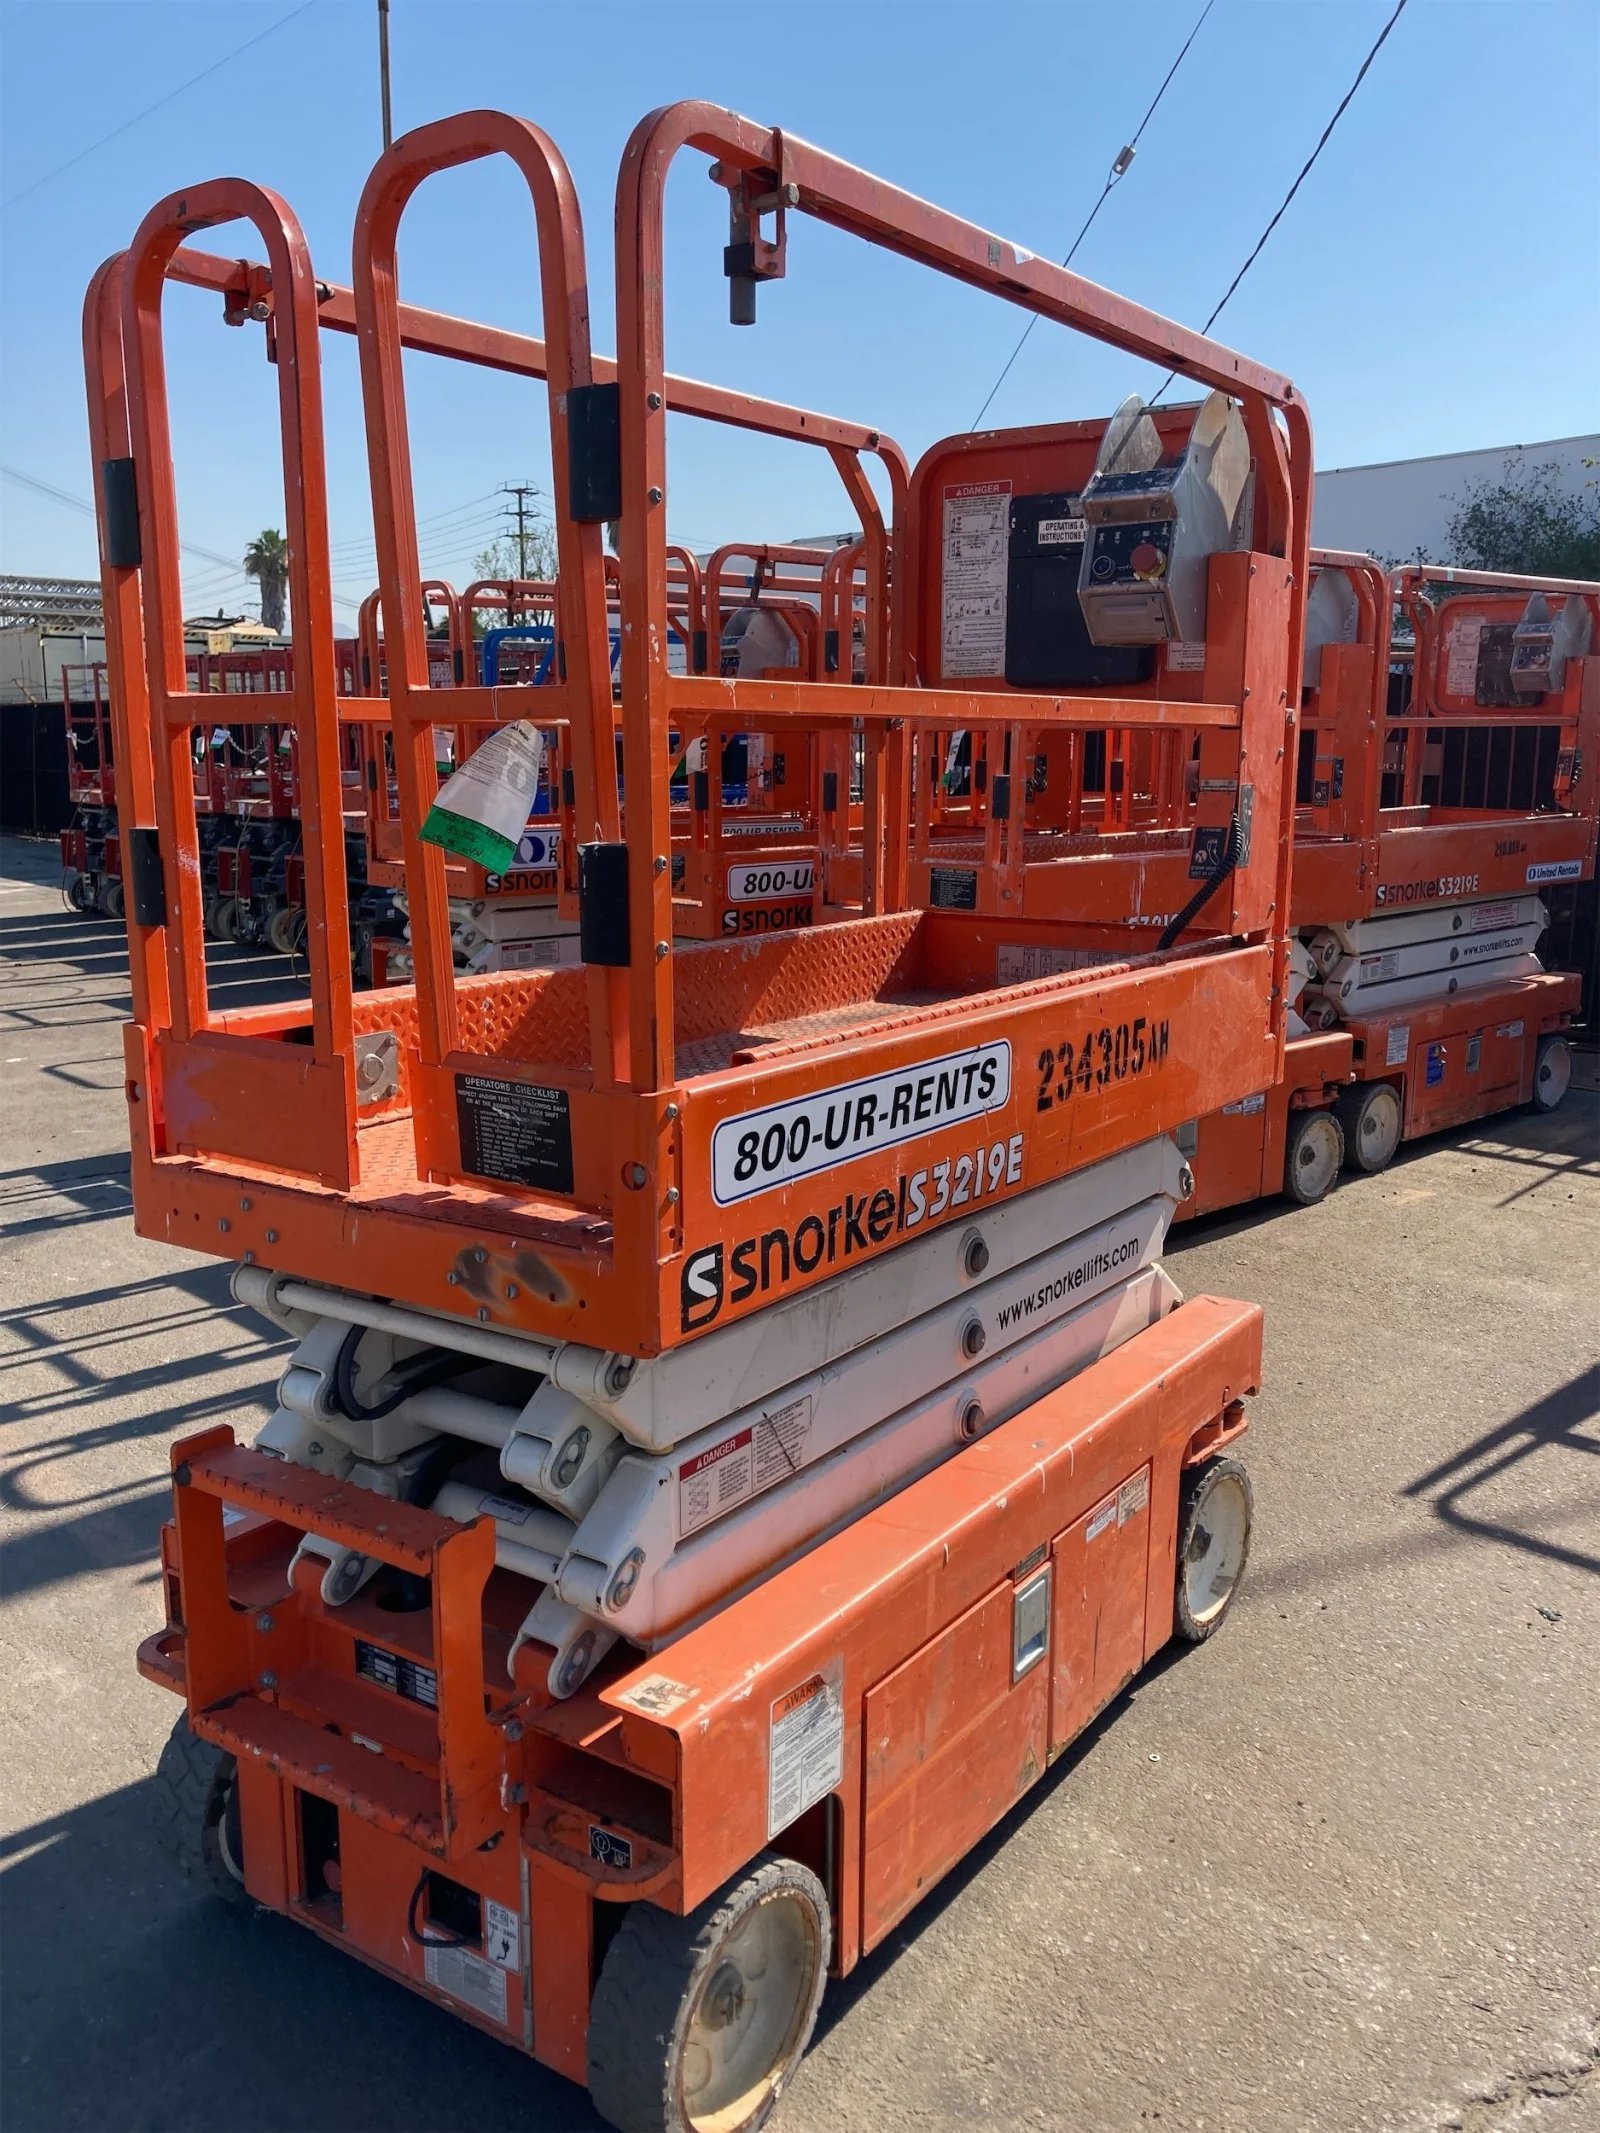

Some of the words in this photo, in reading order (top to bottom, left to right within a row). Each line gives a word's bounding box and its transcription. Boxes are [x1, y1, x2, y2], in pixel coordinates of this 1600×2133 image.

[963, 484, 1000, 496] DANGER
[1040, 532, 1081, 541] INSTRUCTIONS
[1046, 520, 1078, 530] OPERATING
[1536, 864, 1556, 878] United
[1558, 864, 1580, 876] Rentals
[1388, 878, 1438, 903] snorkel
[1464, 936, 1523, 956] www.snorkellifts.com
[465, 1076, 510, 1092] OPERATORS
[516, 1085, 560, 1100] CHECKLIST
[733, 1056, 998, 1182] 800-UR-RENTS
[731, 1176, 907, 1304] snorkel
[906, 1132, 1024, 1228] S3219E
[998, 1236, 1139, 1331] www.snorkellifts.com
[703, 1438, 736, 1467] DANGER
